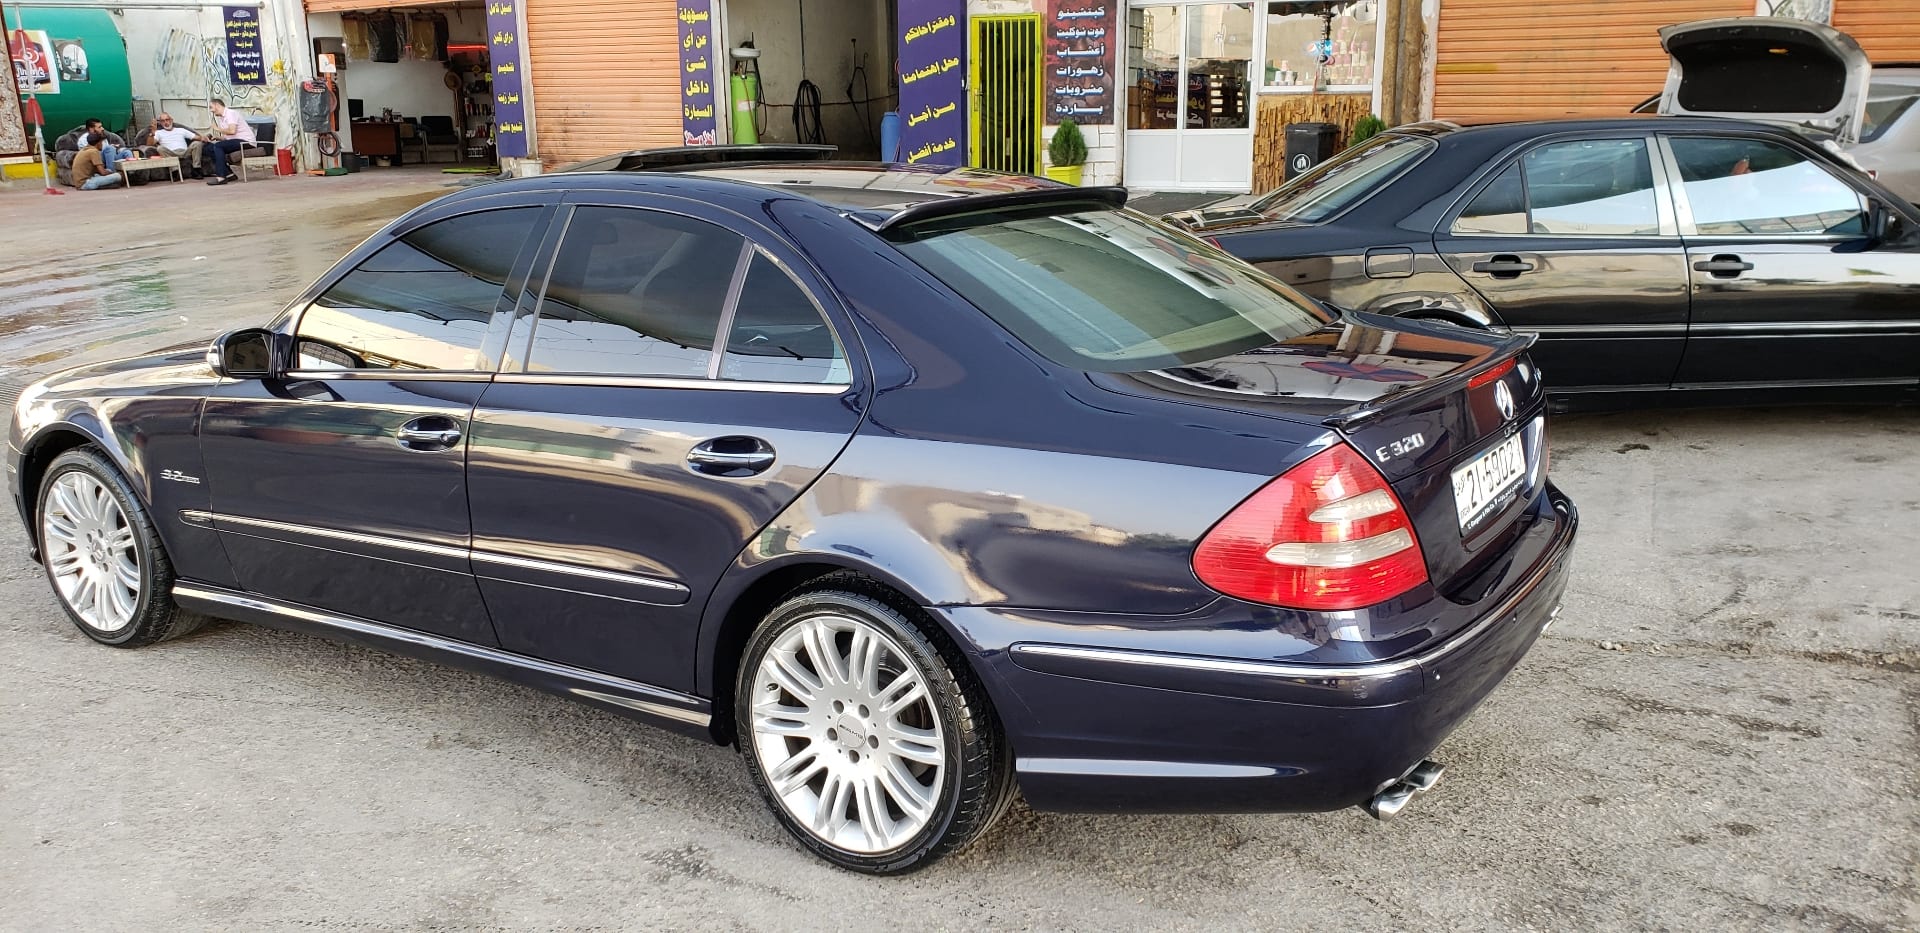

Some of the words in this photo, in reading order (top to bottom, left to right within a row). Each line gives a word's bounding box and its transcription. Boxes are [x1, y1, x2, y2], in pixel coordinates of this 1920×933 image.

[683, 28, 694, 52] أي
[695, 35, 707, 49] عن
[1056, 43, 1104, 58] أعشاب
[941, 57, 959, 72] محل
[1056, 65, 1104, 77] زهورات
[686, 80, 710, 97] داخل
[1055, 84, 1104, 97] مشروبات
[684, 103, 713, 121] السيارة
[908, 105, 932, 127] أجل
[933, 102, 956, 118] من
[1055, 103, 1103, 115] باردة
[907, 142, 932, 164] أفضل
[932, 137, 956, 153] خدمة
[1376, 446, 1391, 462] E
[1390, 433, 1425, 457] 320
